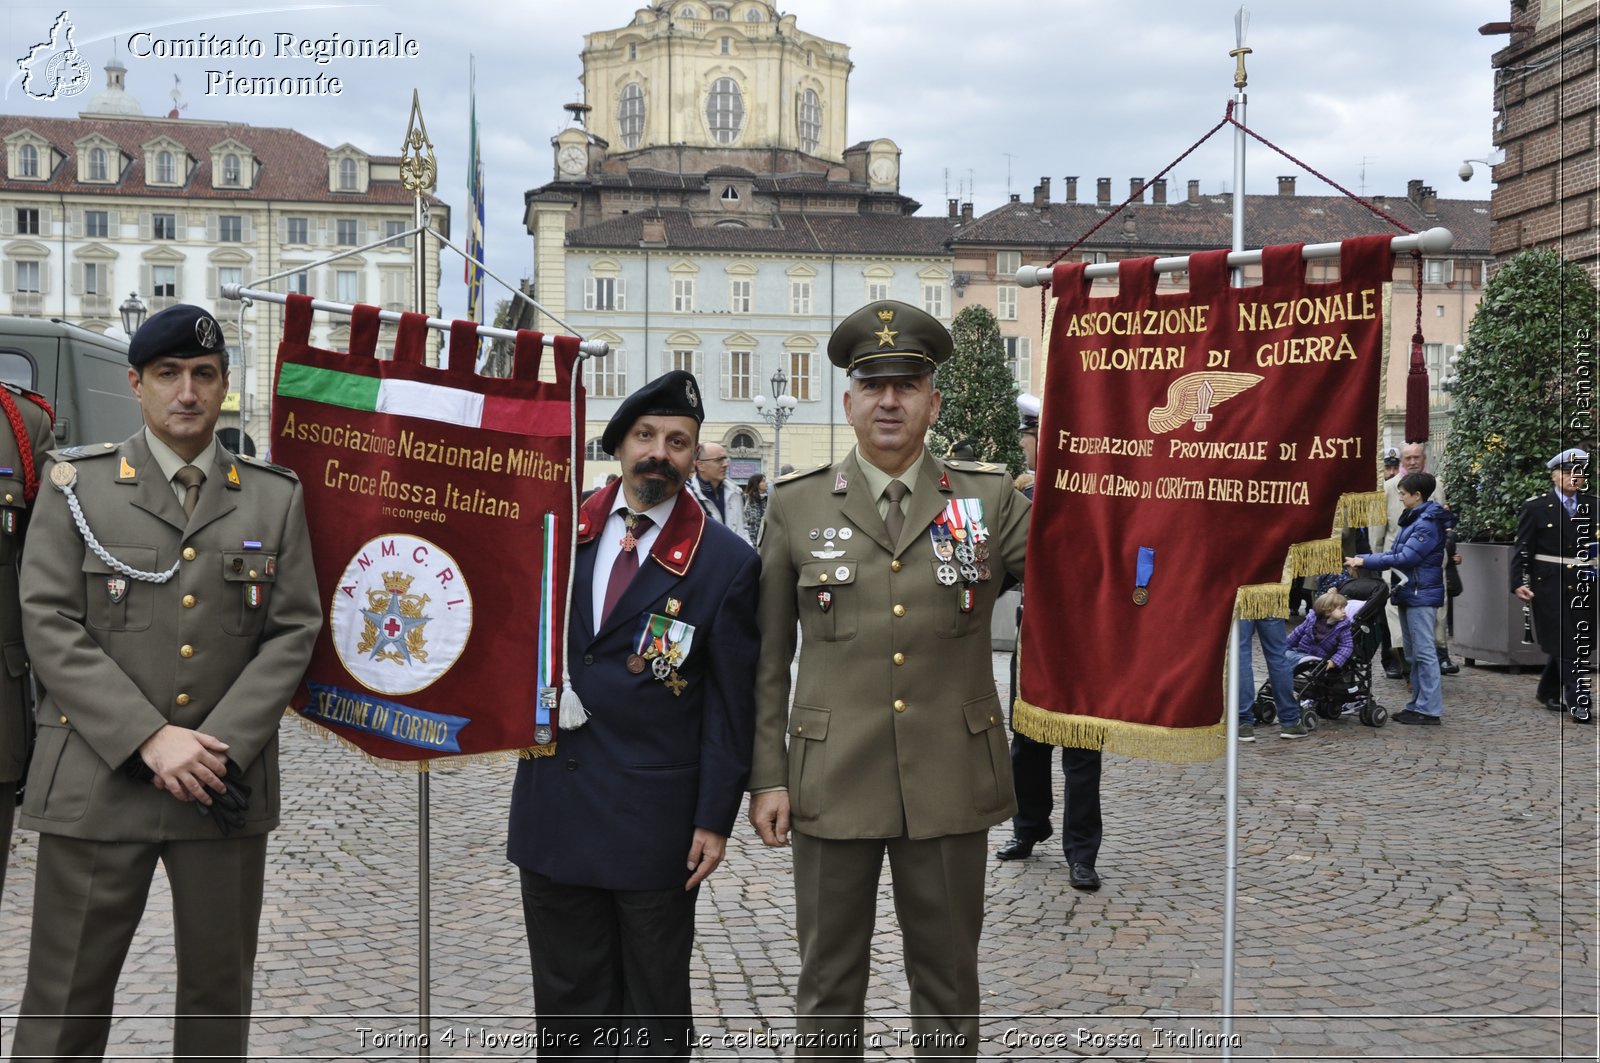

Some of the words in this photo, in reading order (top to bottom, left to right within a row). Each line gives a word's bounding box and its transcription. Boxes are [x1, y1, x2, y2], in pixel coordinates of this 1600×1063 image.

[1065, 305, 1210, 337] ASSOCIAZIONE
[1237, 288, 1376, 332] NAZIONALE
[1079, 346, 1187, 372] VOLONTARI
[1206, 349, 1231, 368] DI
[1256, 333, 1358, 368] GUERRA
[280, 411, 397, 456] Associazione
[397, 430, 503, 473] Nazionale
[506, 447, 571, 483] Militari
[1057, 429, 1155, 458] FEDERAZIONE
[1168, 438, 1268, 461] PROVINCIALE
[1279, 442, 1298, 461] DI
[1307, 436, 1363, 460] ASTI
[324, 458, 377, 495] Croce
[378, 470, 437, 506] Rossa
[444, 483, 521, 520] Italiana
[1140, 481, 1152, 499] DI
[1207, 478, 1243, 502] ENER
[1246, 480, 1311, 505] BETTICA
[316, 691, 372, 728] SEZIONE
[371, 704, 388, 731] DI
[391, 709, 448, 745] TORINO
